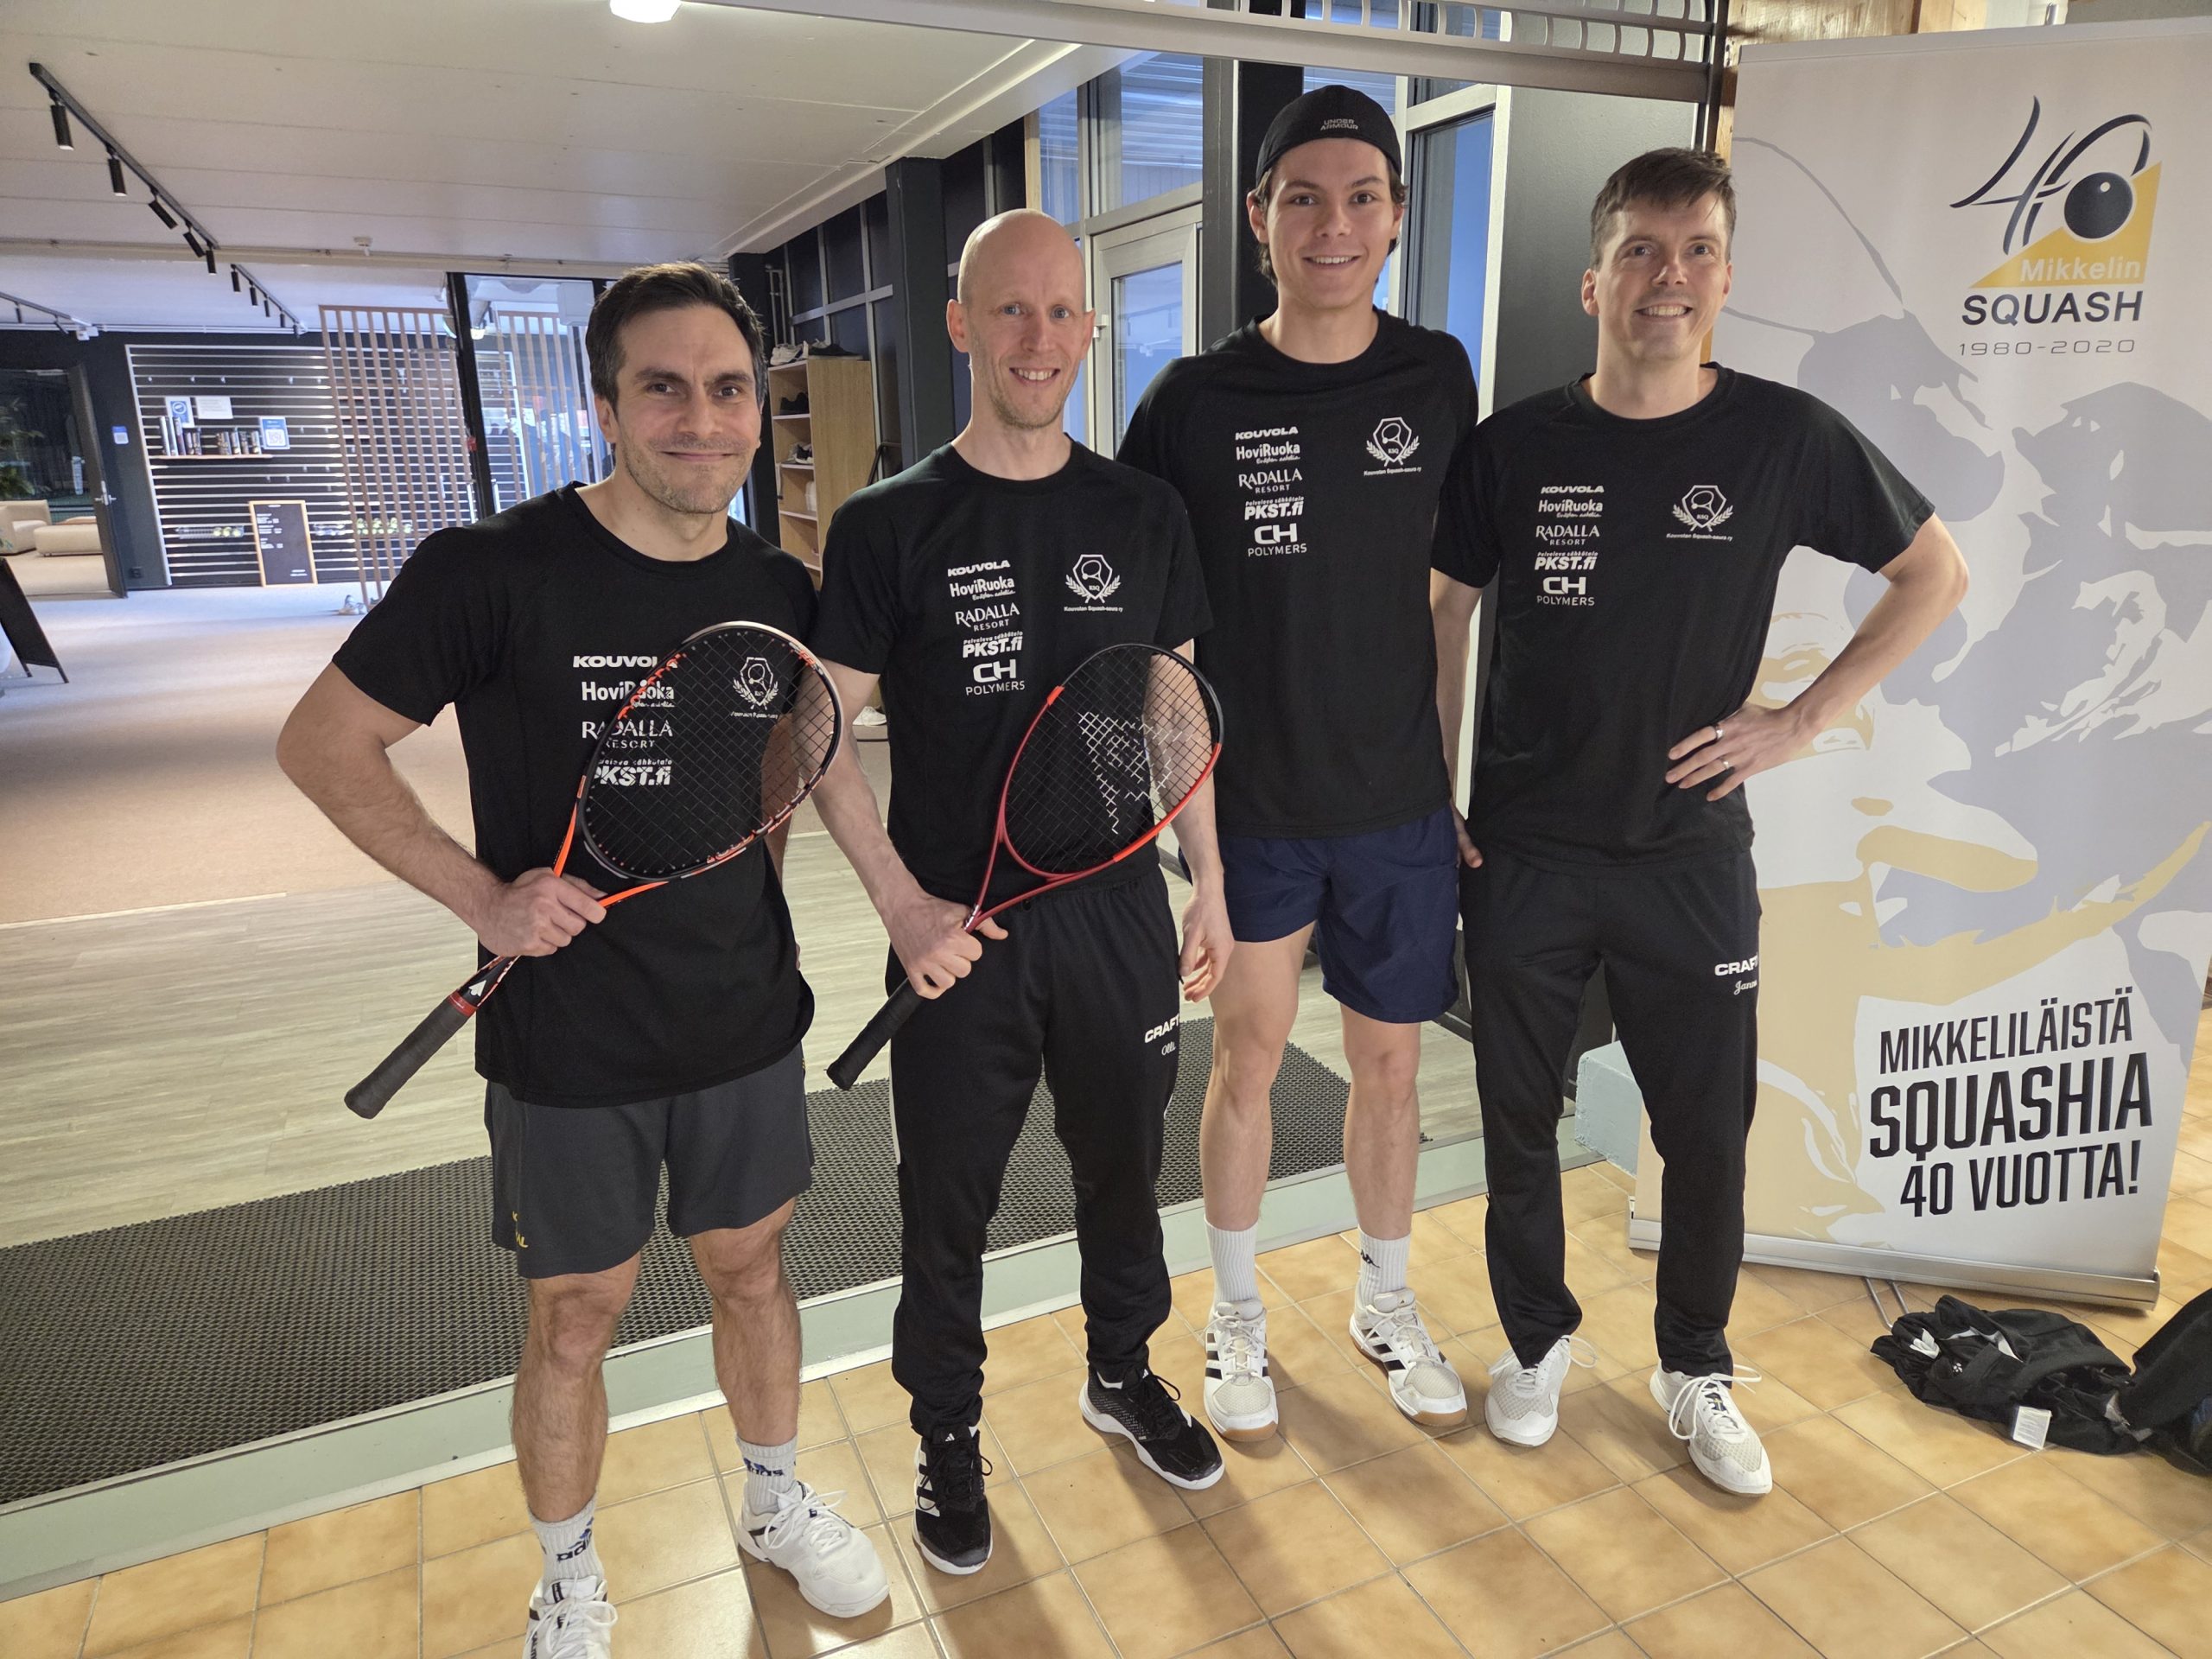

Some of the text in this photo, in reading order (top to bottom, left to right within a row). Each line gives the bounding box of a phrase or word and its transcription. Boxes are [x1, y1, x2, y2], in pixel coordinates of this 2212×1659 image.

[2019, 256, 2141, 283] Mikkelin
[1961, 290, 2143, 327] SQUASH
[1958, 339, 2135, 357] 1980-2020
[1235, 426, 1299, 440] KOUVOLA
[1236, 441, 1300, 461] HoviRuoka
[1238, 468, 1303, 490] RADALLA
[1255, 484, 1290, 494] RESORT
[1541, 485, 1605, 494] KOUVOLA
[1244, 500, 1304, 520] PKST.fi
[1538, 499, 1604, 512] HoviRuoka
[1255, 523, 1298, 544] CH
[1535, 524, 1600, 541] RADALLA
[1248, 543, 1307, 557] POLYMERS
[947, 559, 1011, 577] KOUVOLA
[1535, 556, 1598, 570] PKST.fi
[950, 575, 1015, 598] HoviRuoka
[1542, 576, 1586, 595] CH
[1536, 595, 1595, 607] POLYMERS
[955, 602, 1020, 628] RADALLA
[974, 619, 1009, 632] RESORT
[963, 636, 1023, 658] PKST.fi
[973, 659, 1016, 683] CH
[965, 680, 1025, 696] POLYMERS
[1144, 1013, 1179, 1044] CRAFT
[1879, 986, 2133, 1074] MIKKELILÄISTÄ
[1870, 1052, 2152, 1161] SQUASHIA
[1900, 1140, 2141, 1217] 40 VUOTTA!
